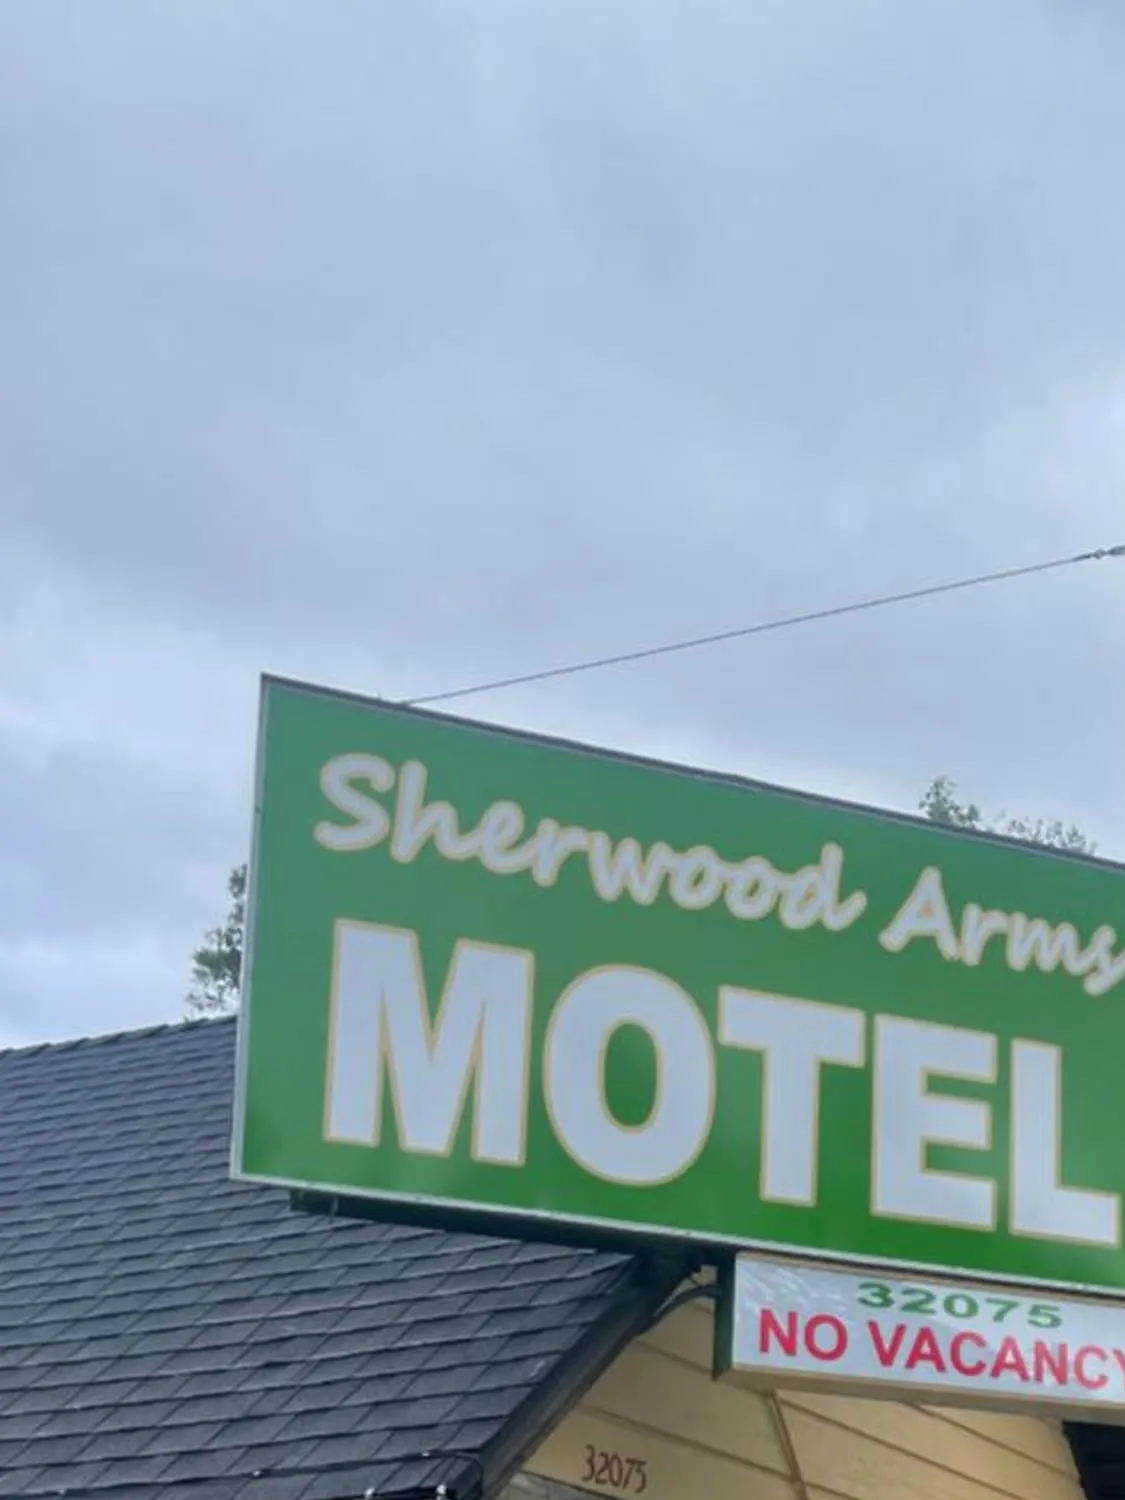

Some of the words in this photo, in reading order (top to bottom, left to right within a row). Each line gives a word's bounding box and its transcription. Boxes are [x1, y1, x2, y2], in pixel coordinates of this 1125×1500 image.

[314, 753, 867, 932] Sherwood
[323, 918, 1122, 1248] MOTEL
[858, 1281, 1062, 1329] 32075
[758, 1308, 847, 1363] NO
[581, 1443, 648, 1494] 32075
